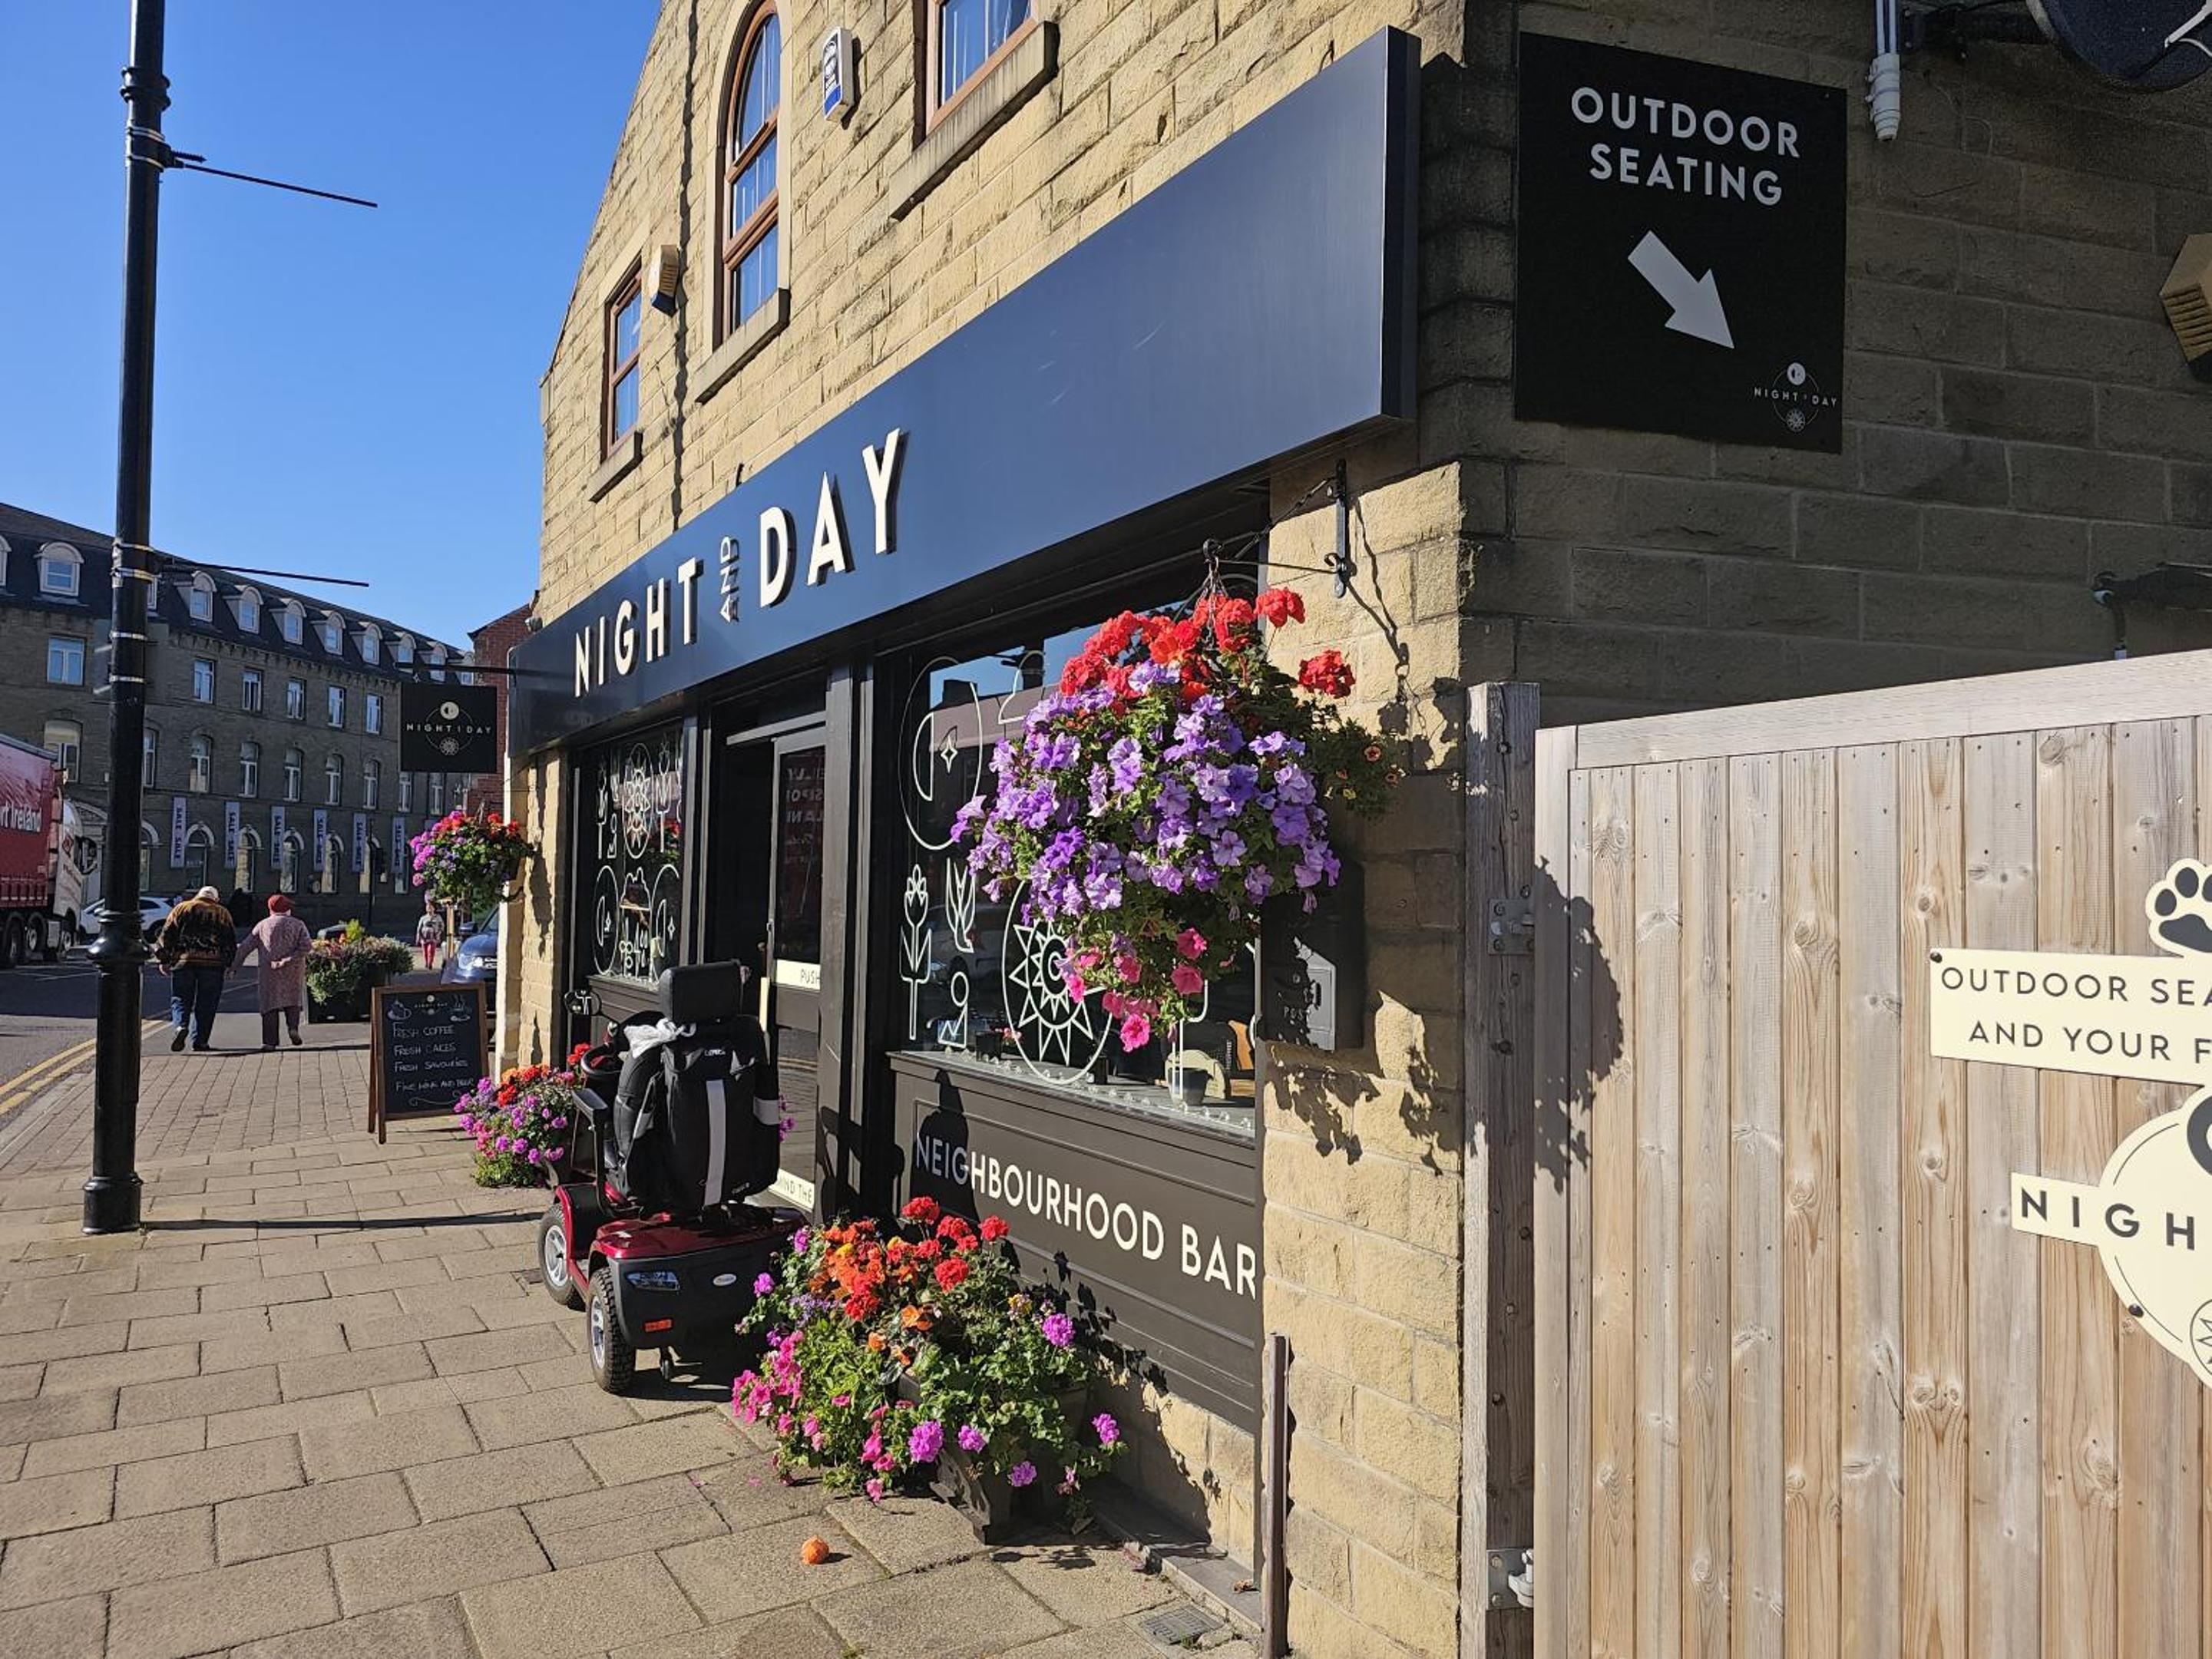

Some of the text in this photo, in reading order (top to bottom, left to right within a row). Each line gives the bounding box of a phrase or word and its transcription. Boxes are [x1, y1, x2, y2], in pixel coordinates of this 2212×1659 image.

[1571, 86, 1800, 158] OUTDOOR
[1589, 143, 1782, 206] SEATING
[1754, 386, 1798, 402] NIGHT
[1812, 395, 1837, 407] DAY
[574, 428, 903, 698] NIGHT AND DAY
[406, 723, 452, 732] NIGHT
[11, 800, 42, 833] Ireland
[1941, 967, 2128, 1001] OUTDOOR
[423, 1024, 455, 1036] COFFEE
[1969, 1021, 2043, 1048] AND
[2063, 1027, 2171, 1062] YOUR
[916, 1132, 1256, 1300] NEIGHBOURHOOD BAR
[2021, 1187, 2195, 1251] NIGH
